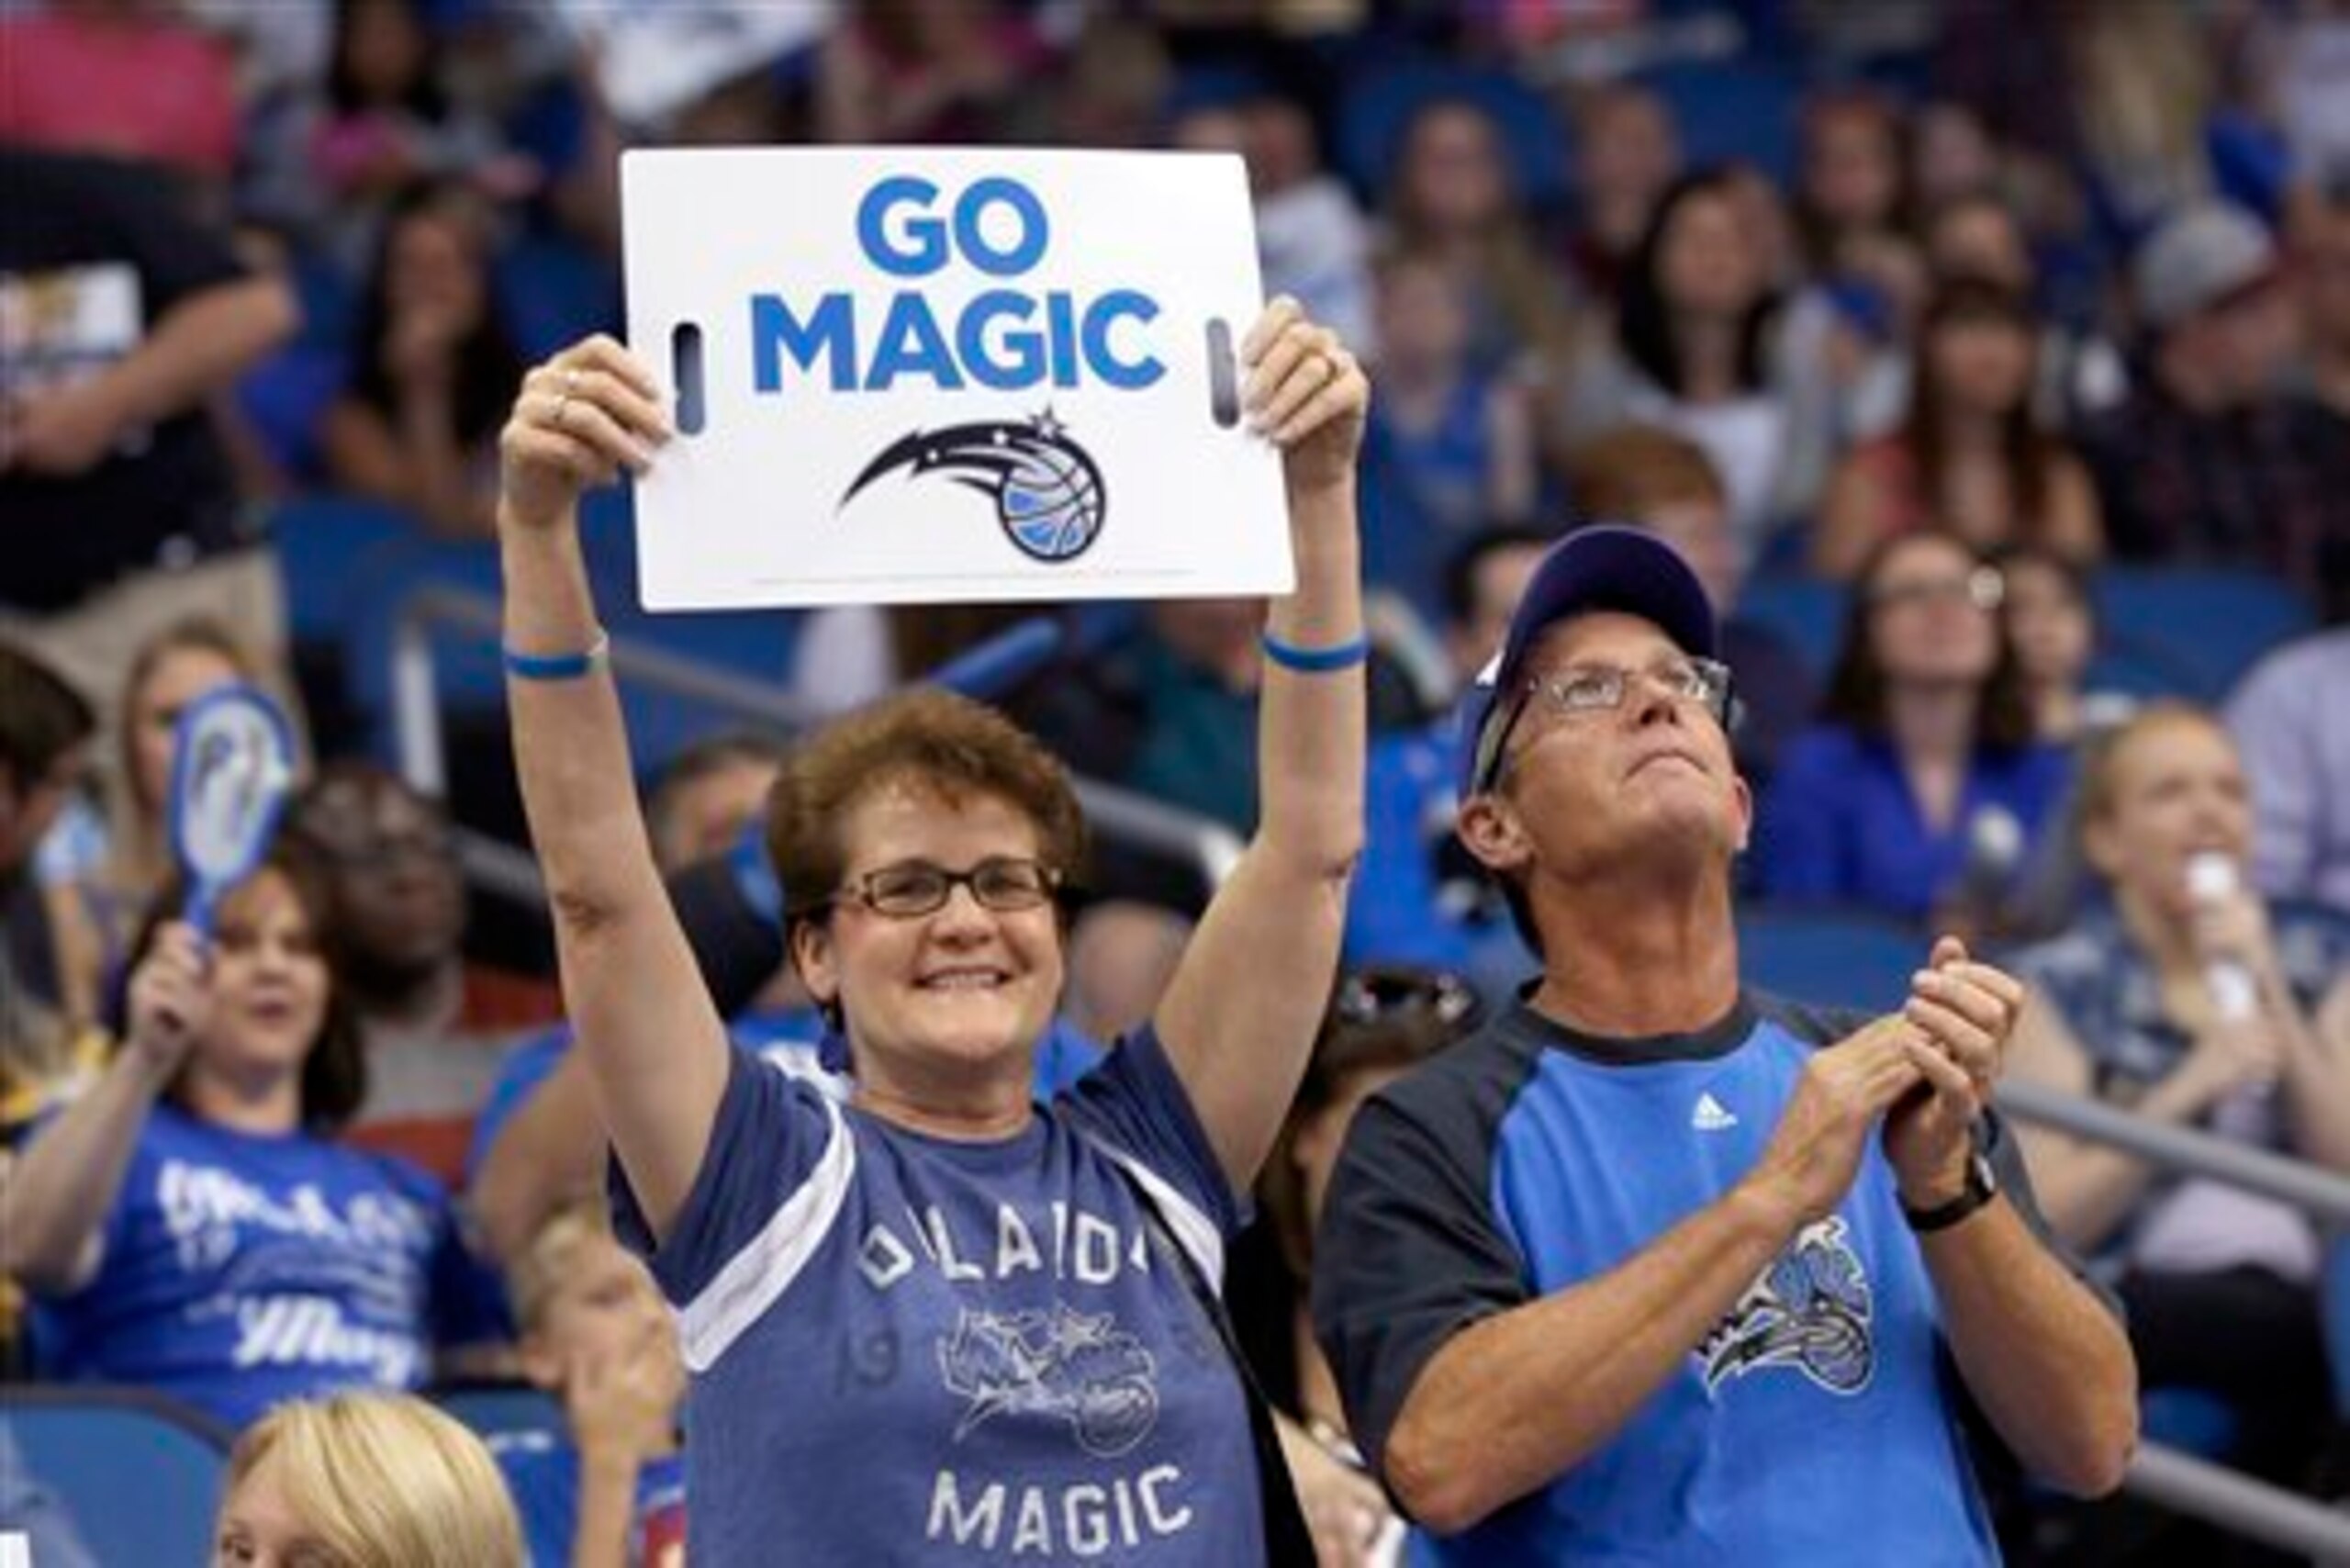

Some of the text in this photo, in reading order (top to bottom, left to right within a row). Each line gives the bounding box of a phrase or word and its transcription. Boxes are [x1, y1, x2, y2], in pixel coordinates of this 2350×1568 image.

[857, 176, 1048, 276] GO
[751, 289, 1167, 394] MAGIC
[857, 1201, 1148, 1288] OLAD
[926, 1463, 1192, 1555] MAGIC
